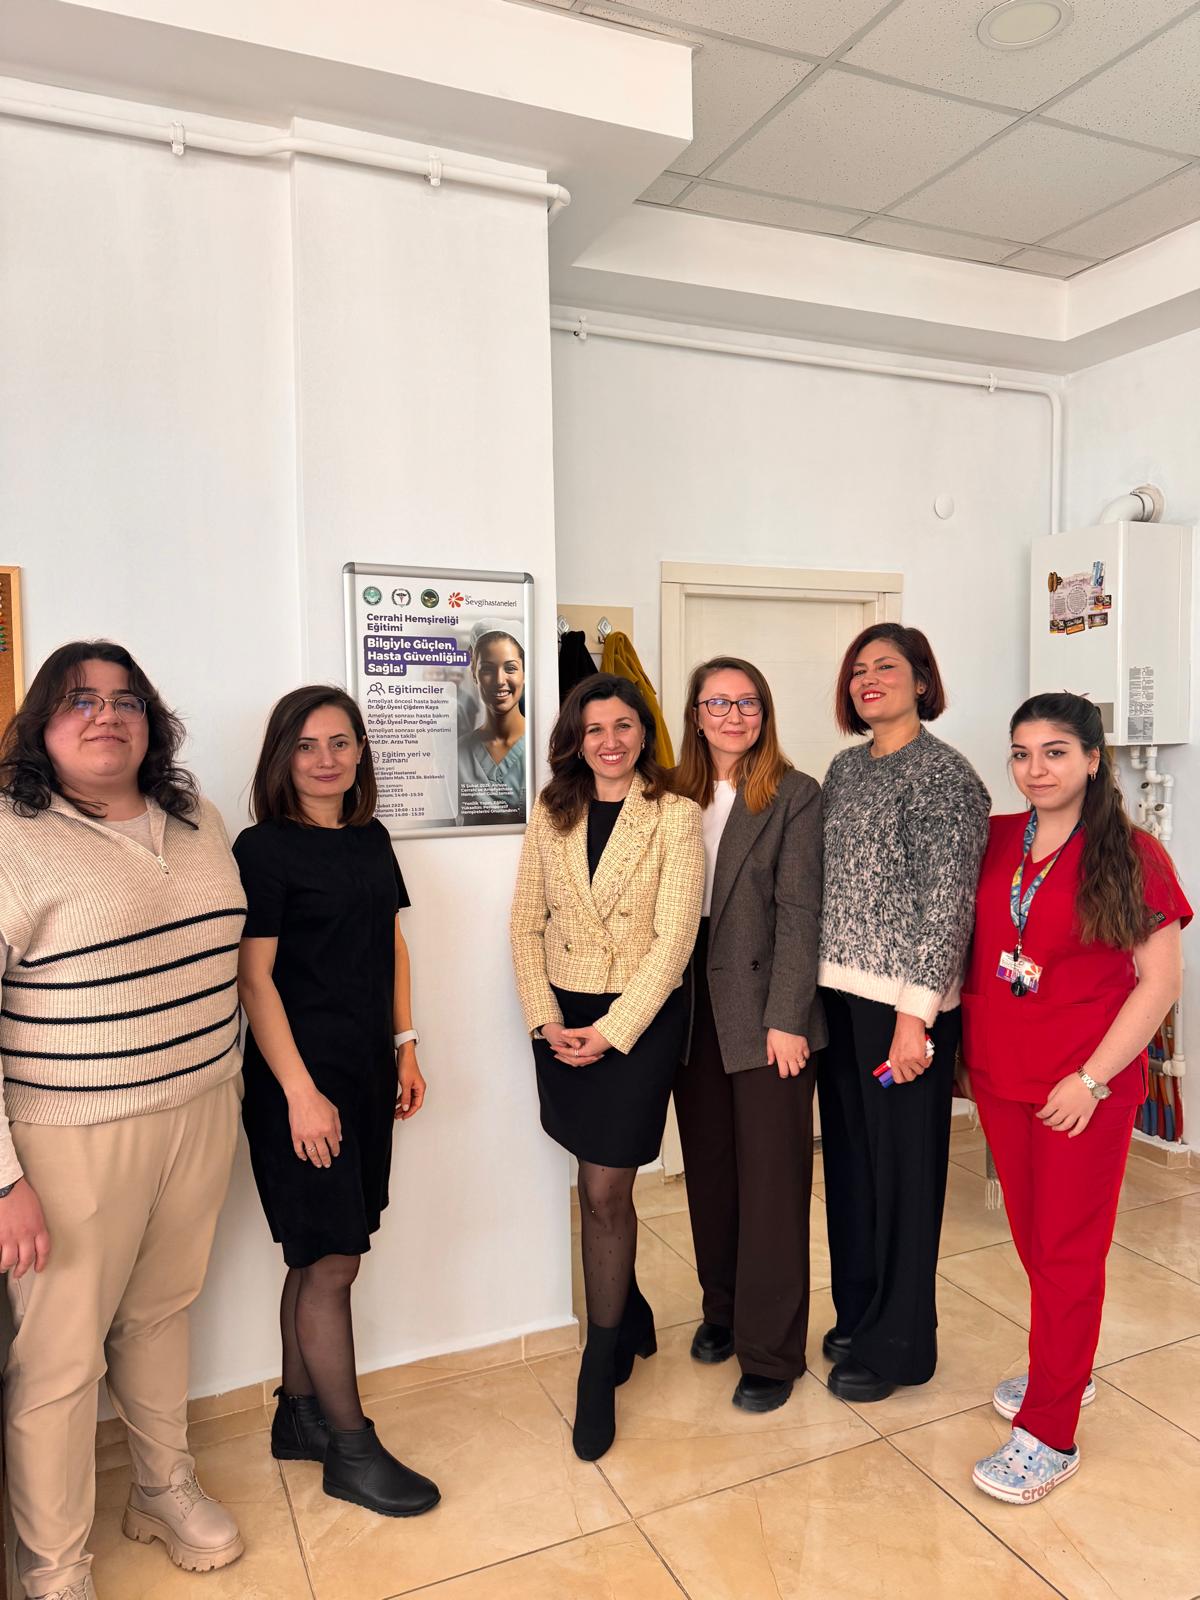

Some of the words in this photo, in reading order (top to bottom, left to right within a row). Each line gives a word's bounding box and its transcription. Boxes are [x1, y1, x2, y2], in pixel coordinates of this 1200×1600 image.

[465, 599, 518, 608] Sevgihastaneleri
[366, 613, 403, 623] Cerrahi
[404, 615, 459, 625] Hemşireliği
[367, 623, 403, 633] Eğitimi
[367, 637, 411, 650] Bilgiyle
[413, 639, 455, 651] Güçlen,
[367, 651, 401, 661] Hasta
[403, 652, 467, 664] Güvenliğini
[368, 663, 404, 675] Sağla!
[388, 684, 444, 696] Eğitimciler
[407, 750, 421, 758] yeri
[1021, 1479, 1056, 1501] crocs
